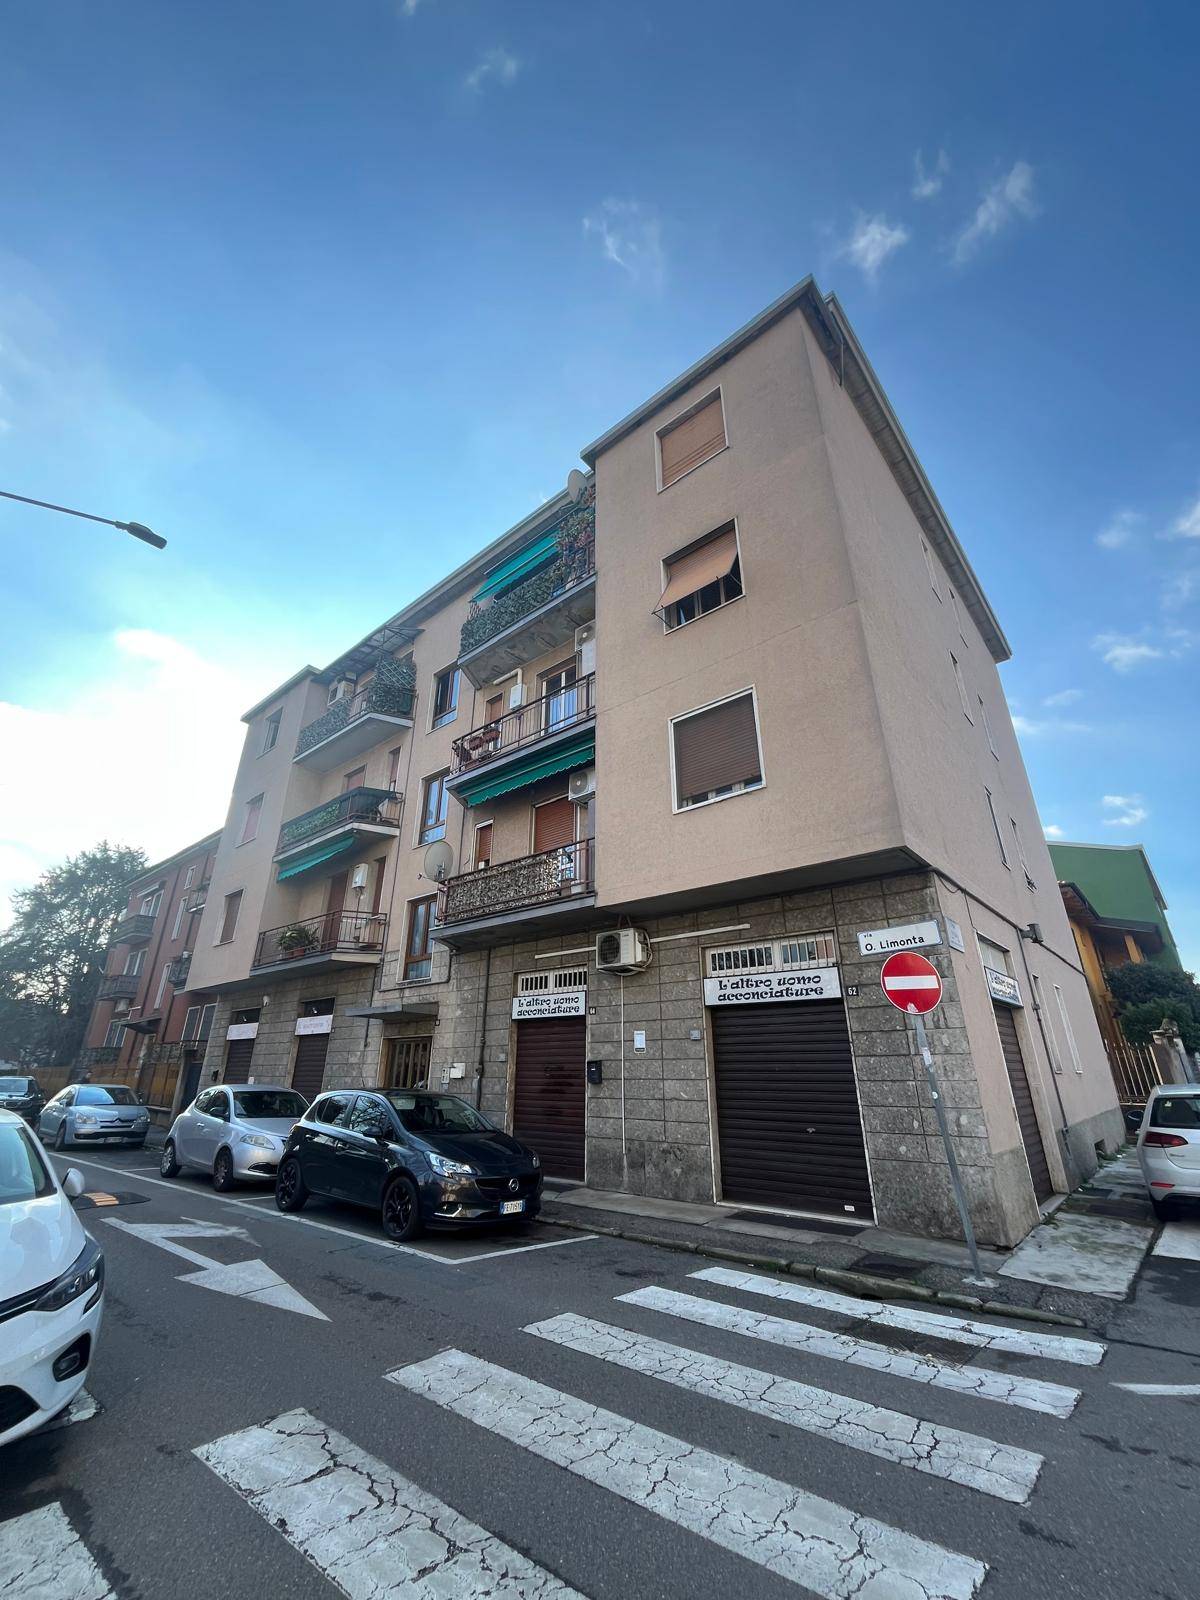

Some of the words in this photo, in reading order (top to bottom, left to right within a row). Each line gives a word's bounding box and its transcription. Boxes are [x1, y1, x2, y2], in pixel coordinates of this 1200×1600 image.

[865, 943, 876, 952] O.
[880, 935, 925, 949] Limonta
[718, 978, 772, 991] L'altro
[777, 975, 821, 986] uomo
[717, 986, 824, 1001] acconciature
[848, 987, 857, 995] 62
[518, 998, 551, 1007] L'altro
[553, 996, 579, 1004] uomo
[516, 1006, 580, 1016] acconciature
